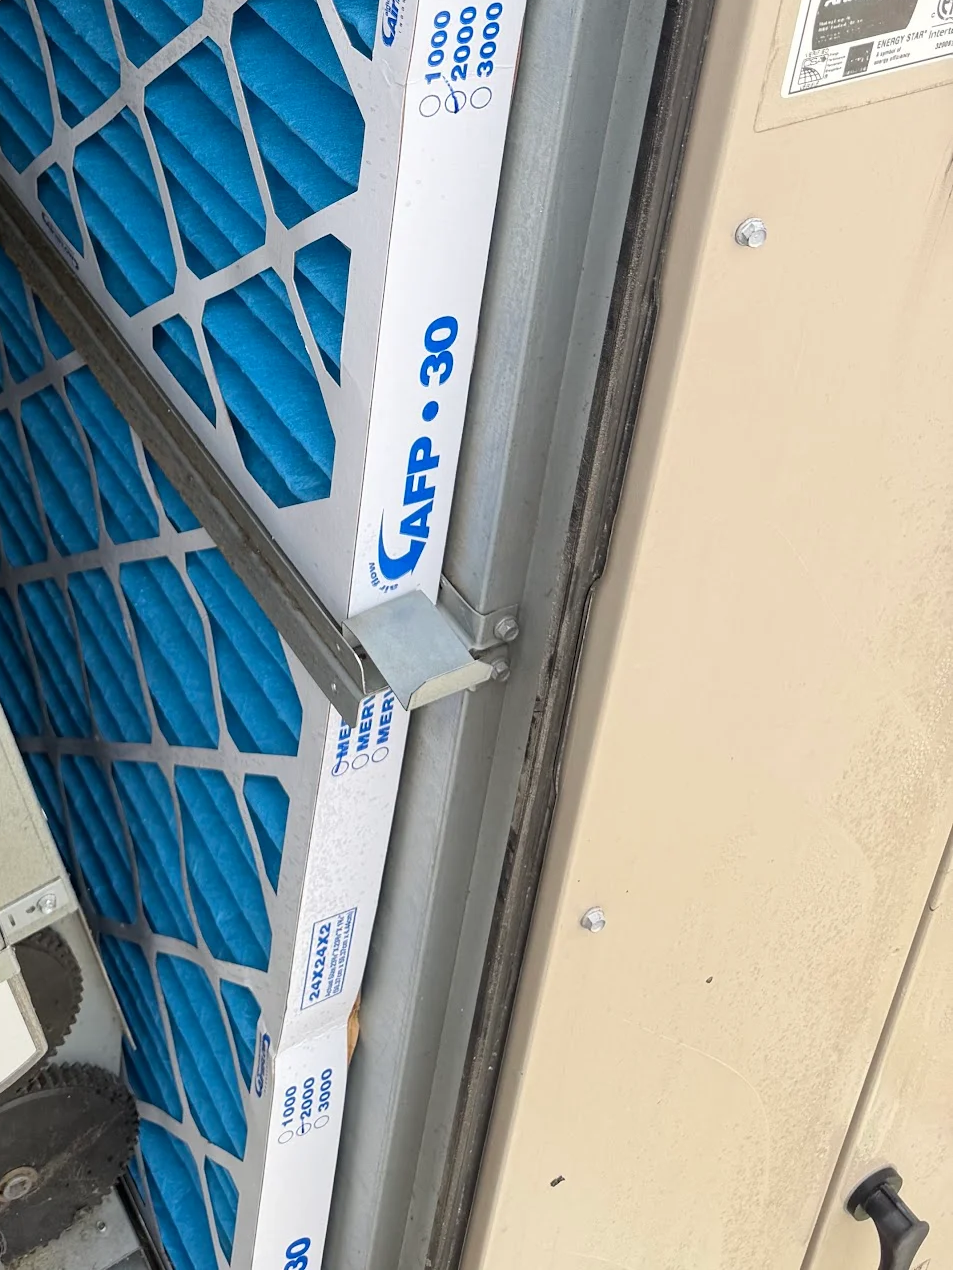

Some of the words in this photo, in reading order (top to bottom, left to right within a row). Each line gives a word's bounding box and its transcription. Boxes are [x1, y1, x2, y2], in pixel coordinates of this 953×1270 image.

[425, 10, 451, 84] 1000
[451, 6, 477, 81] 2000
[477, 2, 503, 77] 3000
[877, 36, 905, 49] ENERGY
[399, 436, 441, 541] AFP
[420, 314, 458, 387] 30
[309, 922, 331, 1002] 24X24X2
[283, 1085, 297, 1127] 1000
[299, 1076, 315, 1120] 2000
[318, 1067, 333, 1112] 3000
[284, 1236, 311, 1270] 30
